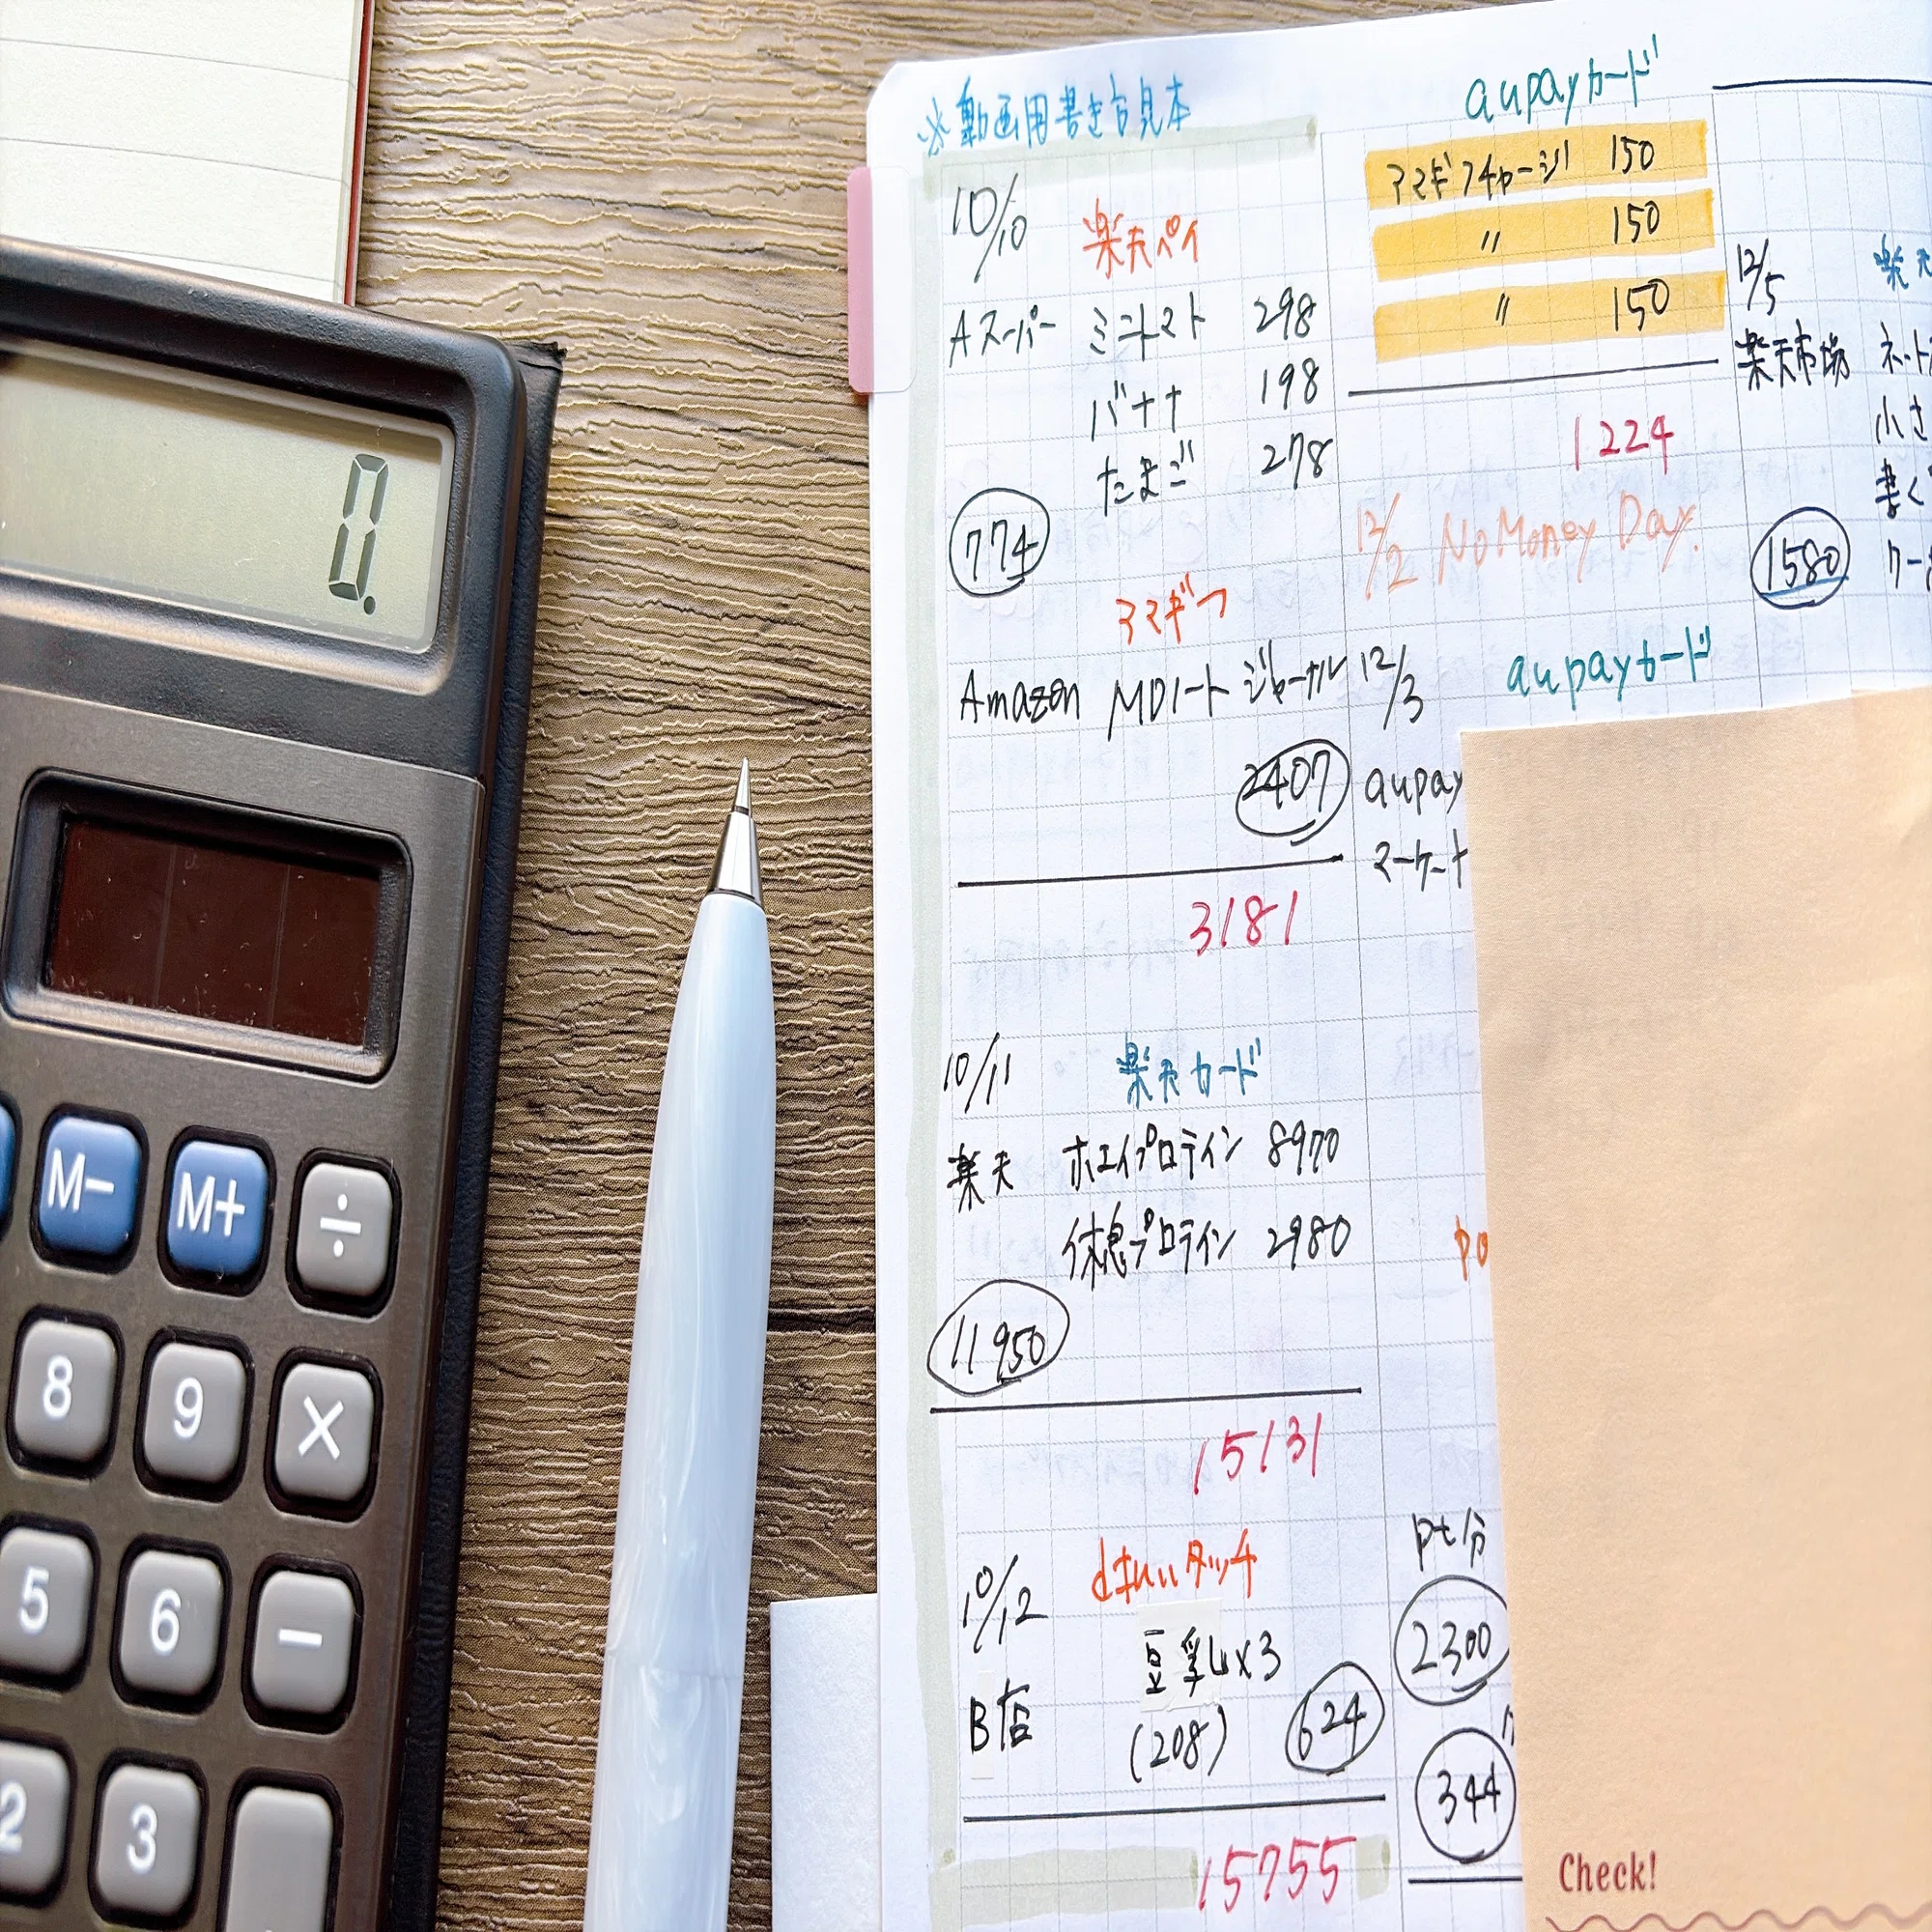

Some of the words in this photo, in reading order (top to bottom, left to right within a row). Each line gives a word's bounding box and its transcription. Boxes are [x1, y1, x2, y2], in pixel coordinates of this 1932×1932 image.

[1611, 133, 1655, 175] 150
[1083, 197, 1199, 280] 楽天ペイ
[1612, 205, 1661, 245] 150
[1612, 277, 1670, 331] 150
[1736, 238, 1785, 317] 12/5
[949, 304, 1057, 369] Aスーパー
[1253, 286, 1317, 340] 298
[1734, 318, 1851, 390] 楽天市場
[1091, 380, 1183, 441] バナナ
[1262, 356, 1321, 411] 198
[1096, 439, 1195, 518] たまご
[1261, 431, 1334, 491] 278
[1574, 412, 1676, 476] 1224
[964, 518, 1039, 583] 774
[1356, 492, 1419, 602] 12/2
[1767, 535, 1841, 592] 1580
[959, 668, 1081, 724] Amazon
[1360, 643, 1424, 731] 12/3
[1241, 750, 1332, 813] 2407
[1189, 889, 1299, 956] 3181
[943, 1032, 1012, 1114] 10/11
[1117, 1031, 1263, 1111] 楽天カード
[176, 1171, 245, 1238] M+
[946, 1142, 1014, 1214] 楽天
[1063, 1122, 1243, 1192] ホエイプロテイン
[1268, 1120, 1340, 1177] 8970
[1062, 1201, 1237, 1293] 休息プロテイン
[1266, 1213, 1352, 1271] 2980
[42, 1354, 74, 1420] 8
[172, 1377, 205, 1439] 9
[1192, 1411, 1323, 1495] 15131
[17, 1566, 51, 1634] 5
[149, 1586, 183, 1656] 6
[962, 1554, 1048, 1654] 10/12
[1411, 1621, 1492, 1677] 2300
[969, 1677, 1034, 1754] B店
[1130, 1706, 1228, 1783] (208)
[1296, 1691, 1368, 1760] 624
[0, 1779, 28, 1852] 2
[127, 1803, 160, 1874] 3
[1437, 1761, 1501, 1824] 344
[1198, 1835, 1357, 1913] 15755
[1557, 1850, 1659, 1893] Check!
